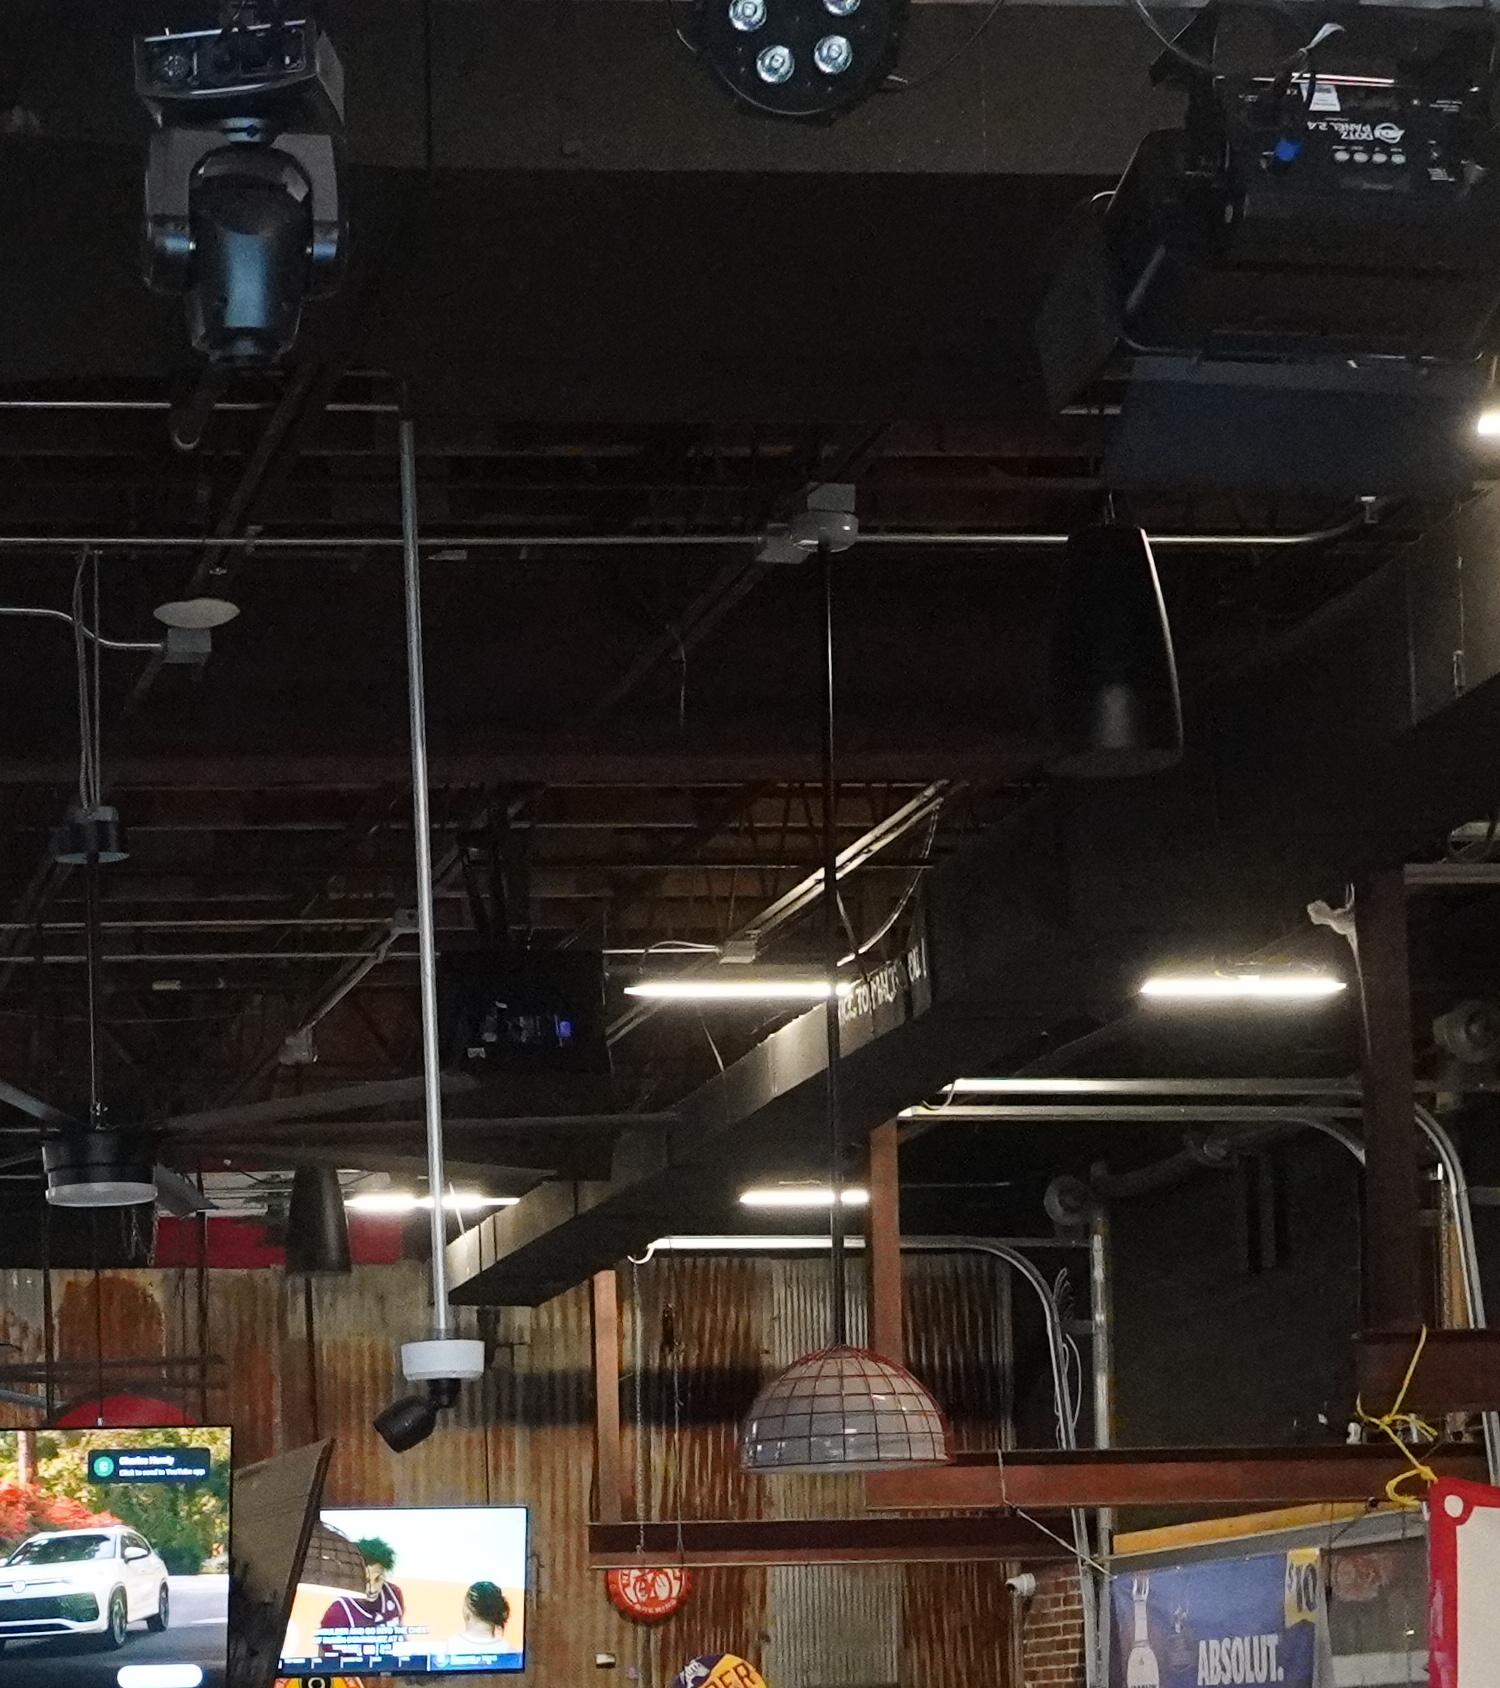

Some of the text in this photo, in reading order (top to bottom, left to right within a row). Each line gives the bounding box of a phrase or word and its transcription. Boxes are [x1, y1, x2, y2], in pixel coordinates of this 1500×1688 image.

[1329, 122, 1373, 133] PANEL
[1340, 131, 1374, 141] DOTZ
[1197, 1633, 1284, 1686] ABSOLUT.
